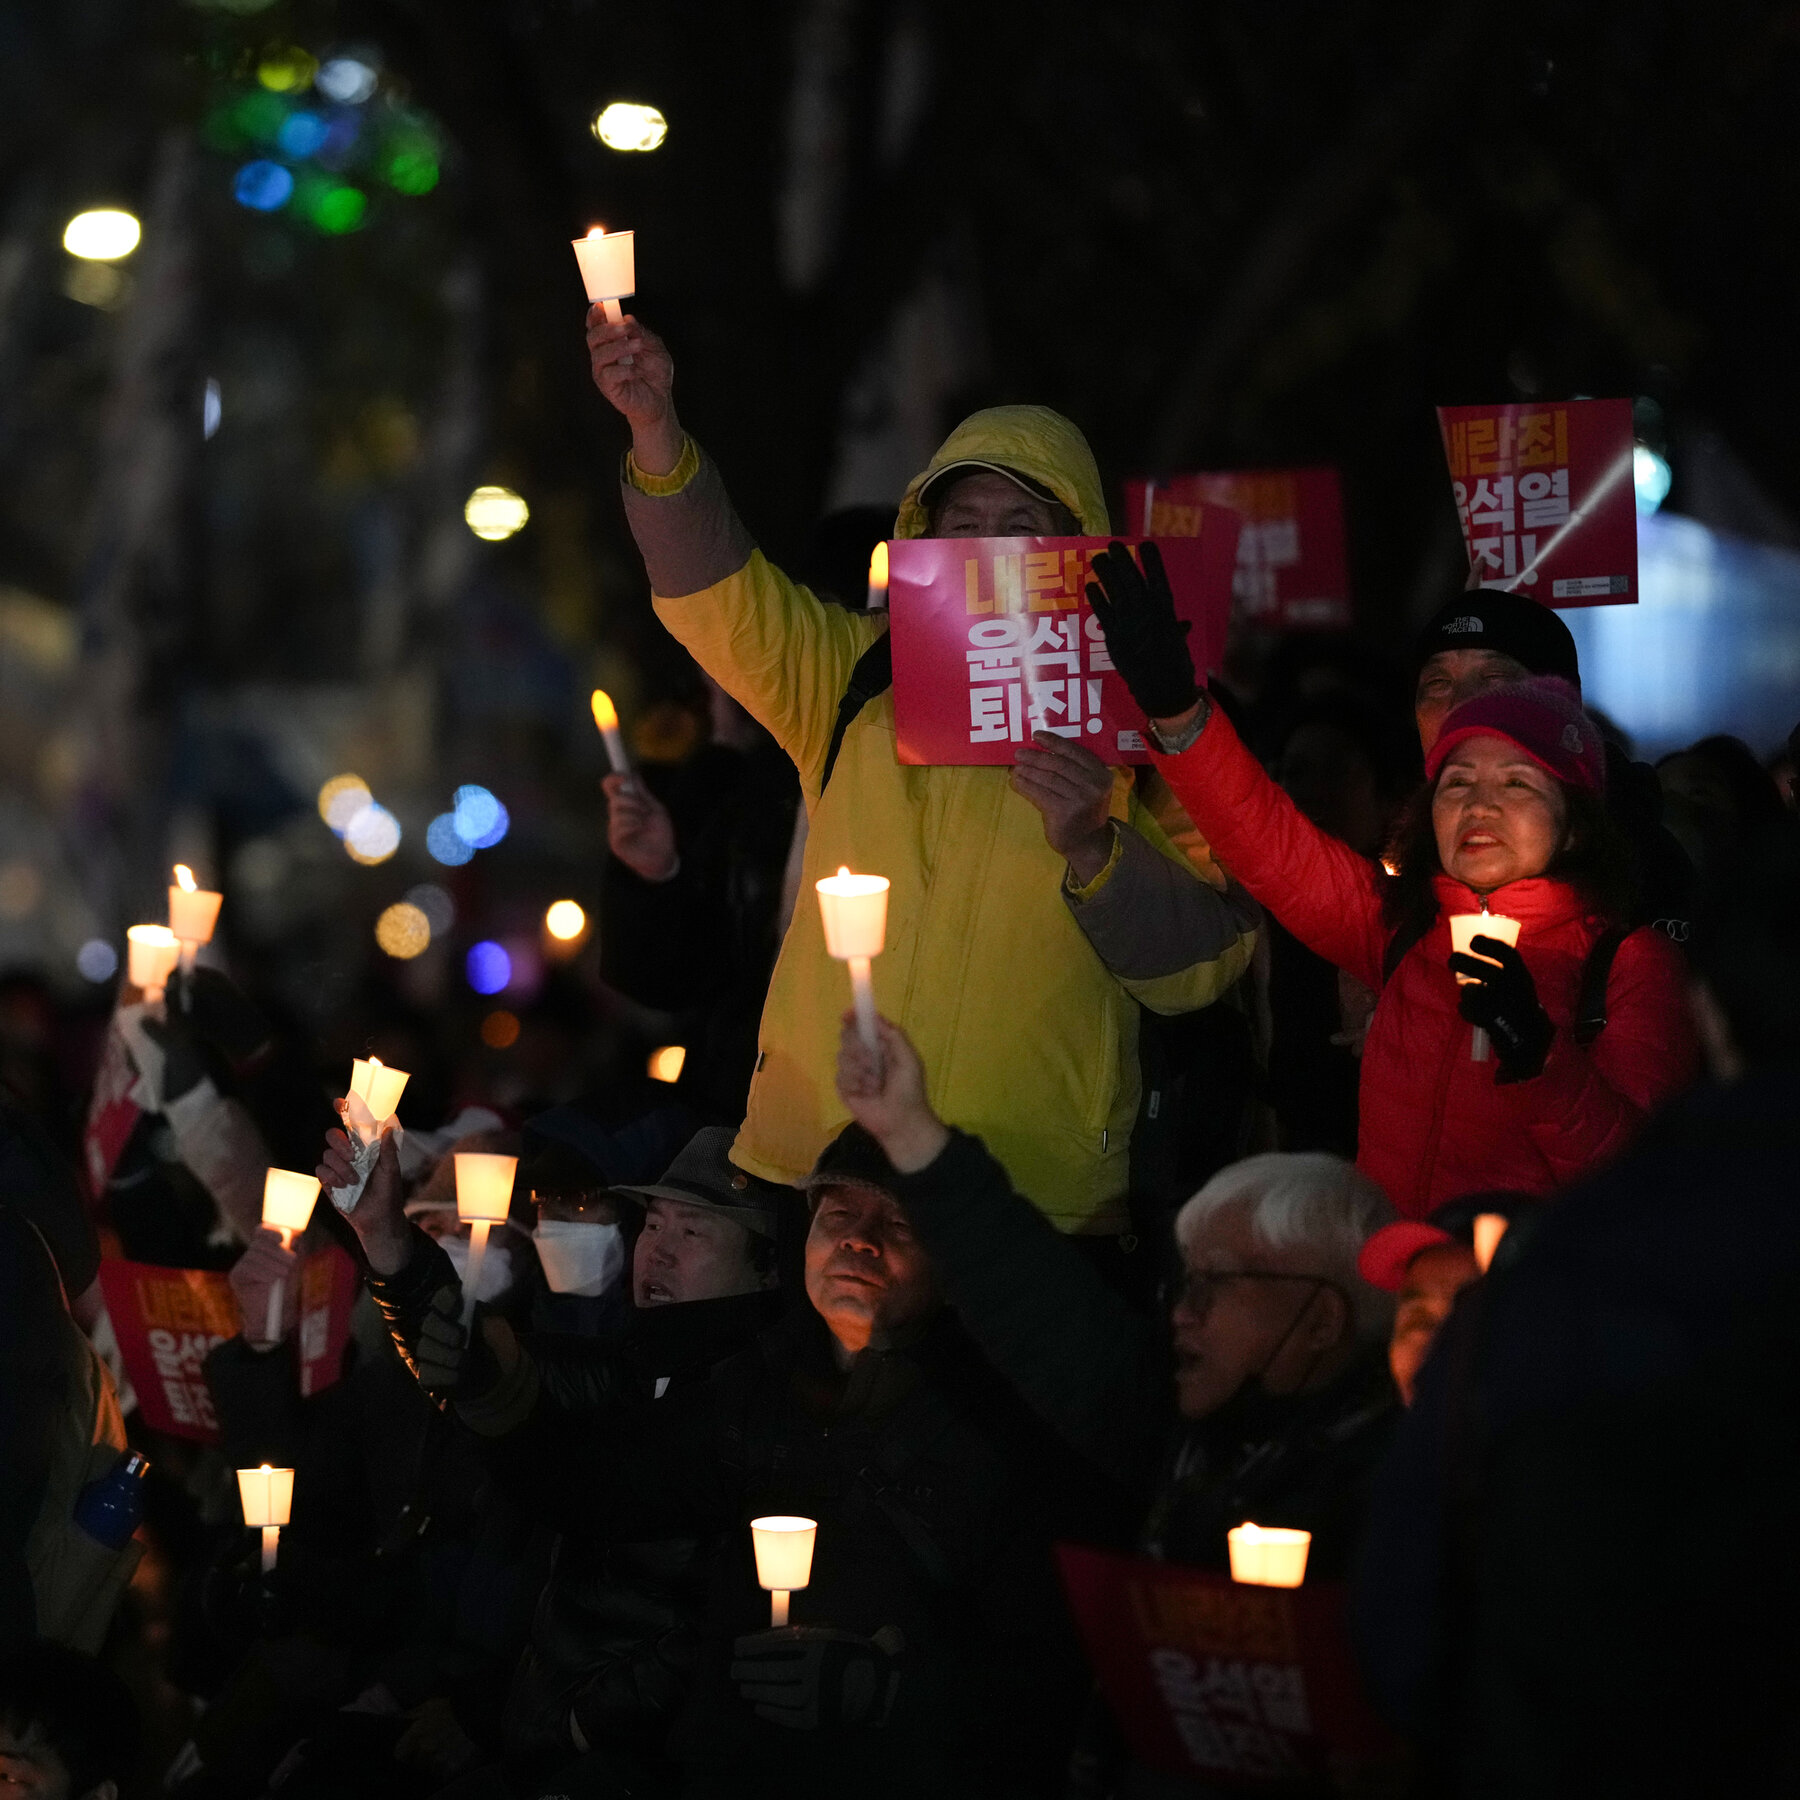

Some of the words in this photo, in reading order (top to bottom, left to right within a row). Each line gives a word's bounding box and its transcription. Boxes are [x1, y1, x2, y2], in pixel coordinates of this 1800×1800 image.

[965, 545, 1135, 615] 내란
[1441, 621, 1469, 631] NORTH
[1447, 627, 1469, 635] FACE
[969, 678, 1103, 743] 퇴진!
